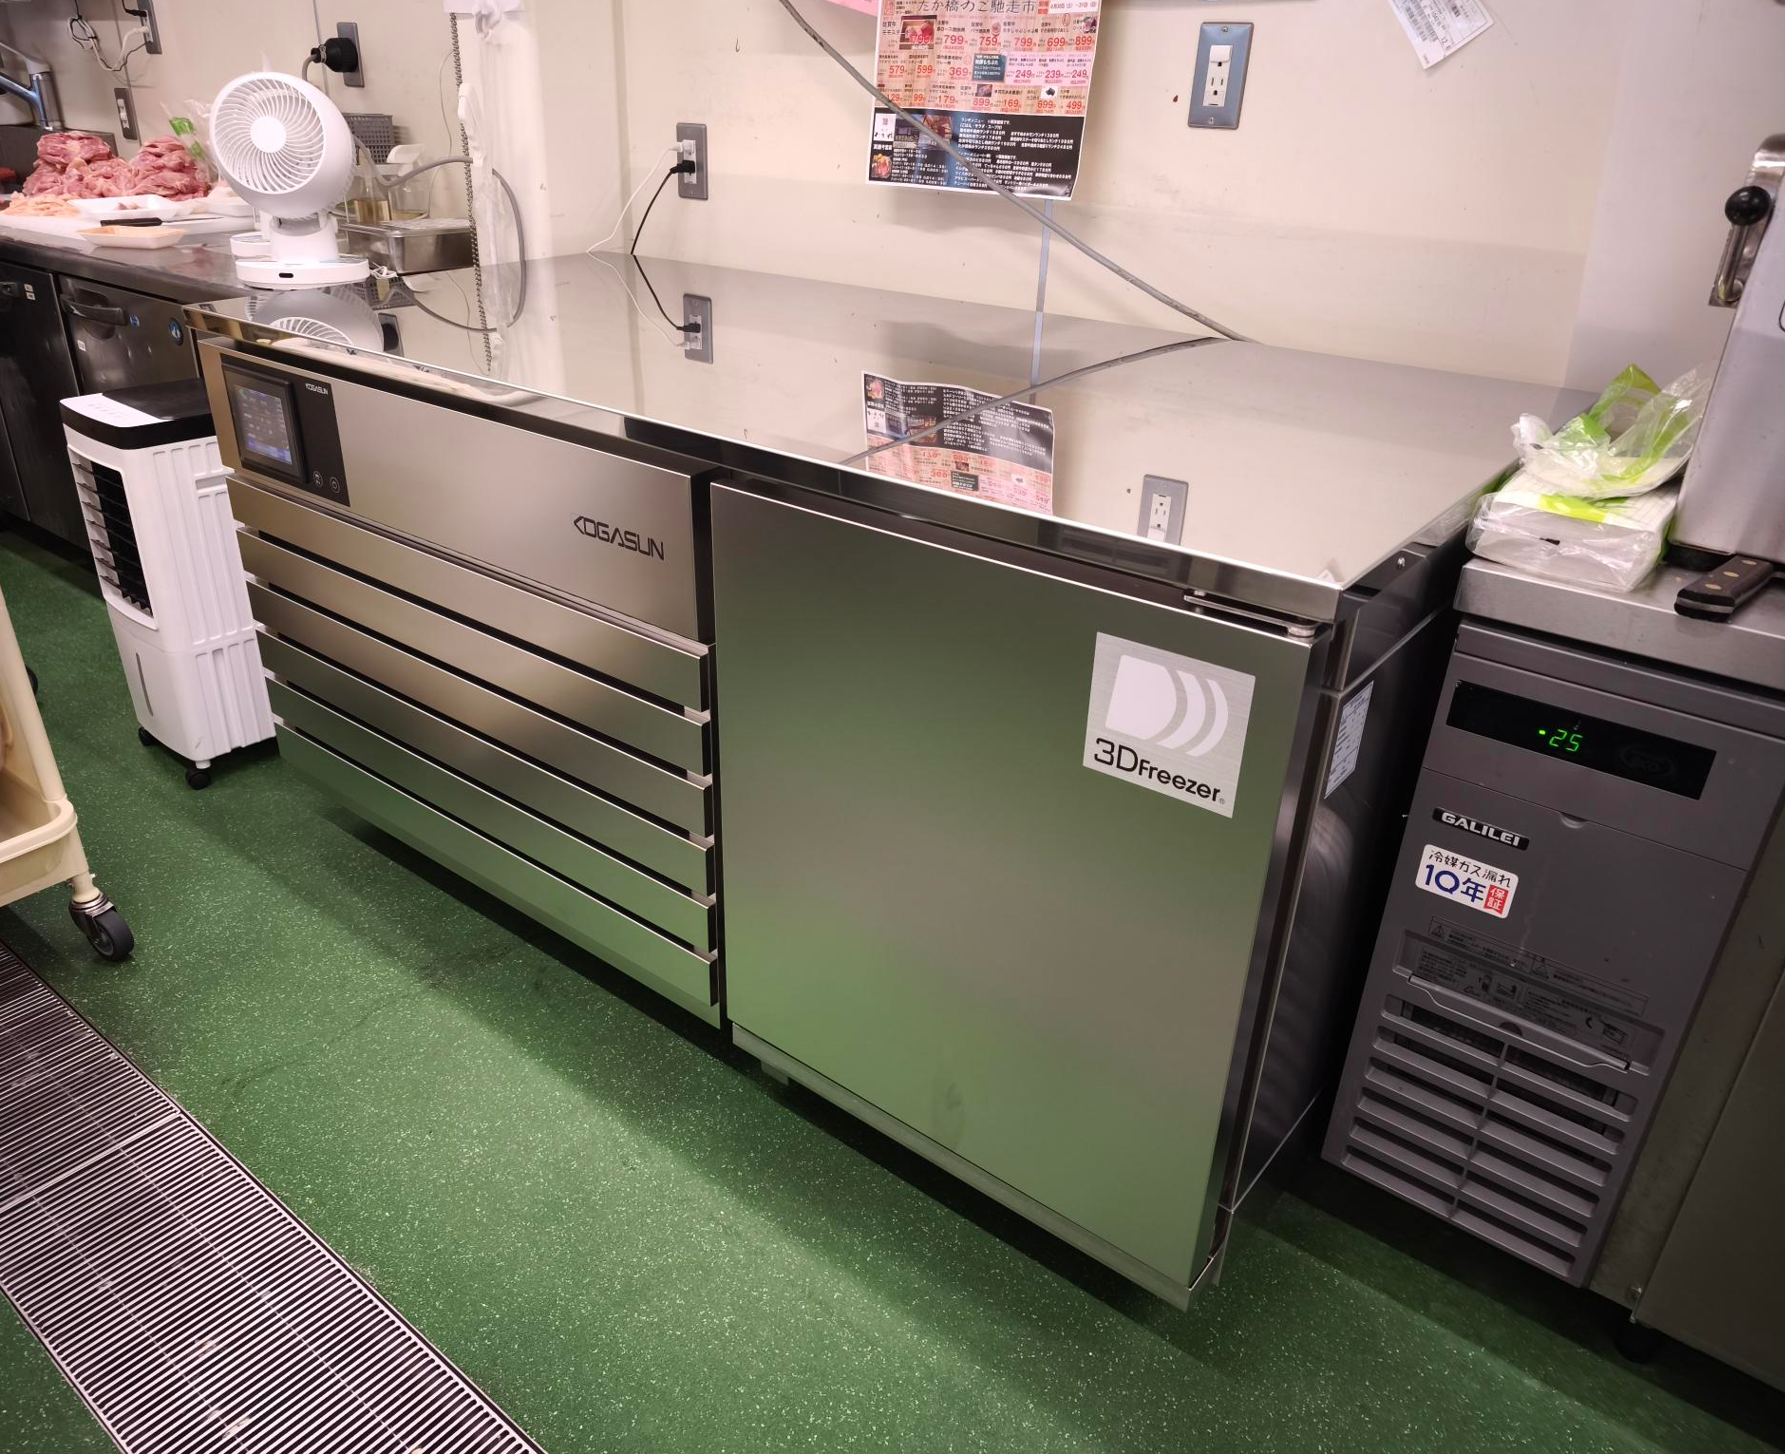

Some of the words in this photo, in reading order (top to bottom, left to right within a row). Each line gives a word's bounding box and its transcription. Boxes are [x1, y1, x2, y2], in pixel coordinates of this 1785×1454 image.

[574, 516, 664, 560] KOGASUN
[1442, 812, 1520, 846] GALILEI
[1429, 850, 1510, 888] 冷媒ガス漏れ
